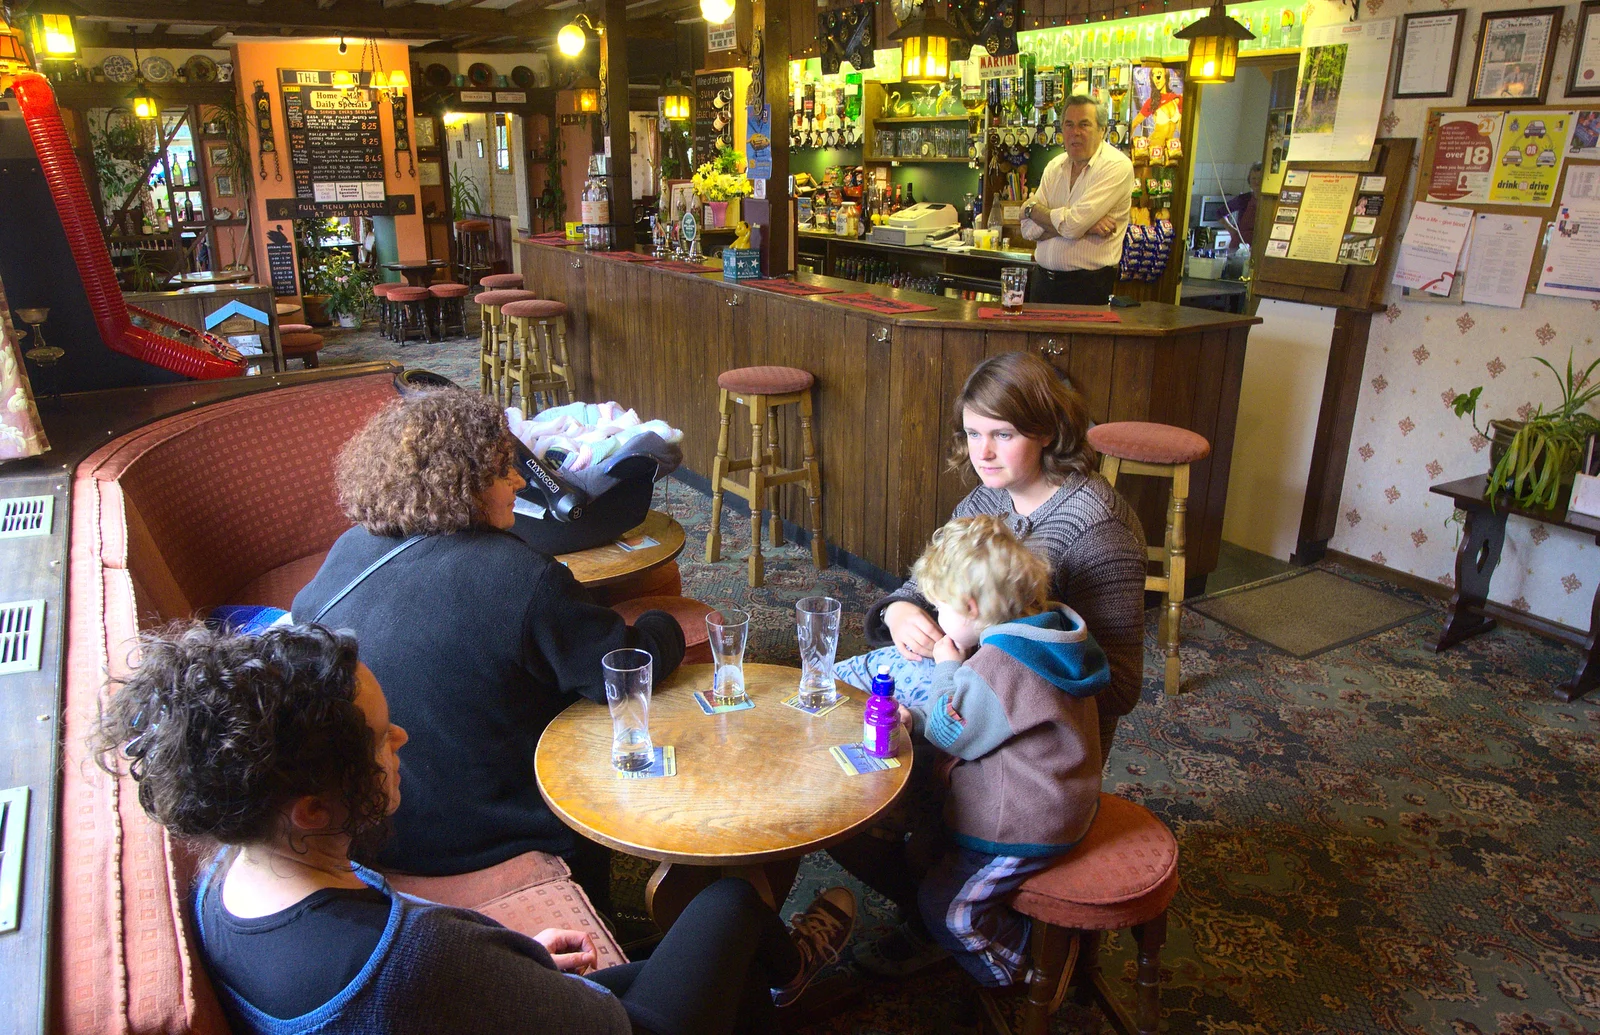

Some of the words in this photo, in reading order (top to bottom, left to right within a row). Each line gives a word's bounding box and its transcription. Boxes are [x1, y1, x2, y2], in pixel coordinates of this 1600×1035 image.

[980, 54, 1016, 68] MARTINI
[298, 72, 318, 83] THE
[332, 74, 358, 83] SN
[697, 76, 706, 85] Wine
[707, 76, 712, 85] of
[718, 74, 732, 83] month
[1479, 120, 1493, 132] 21
[1464, 146, 1490, 165] 18
[1526, 146, 1537, 154] OR
[1498, 180, 1518, 189] drink
[1529, 181, 1549, 190] drive
